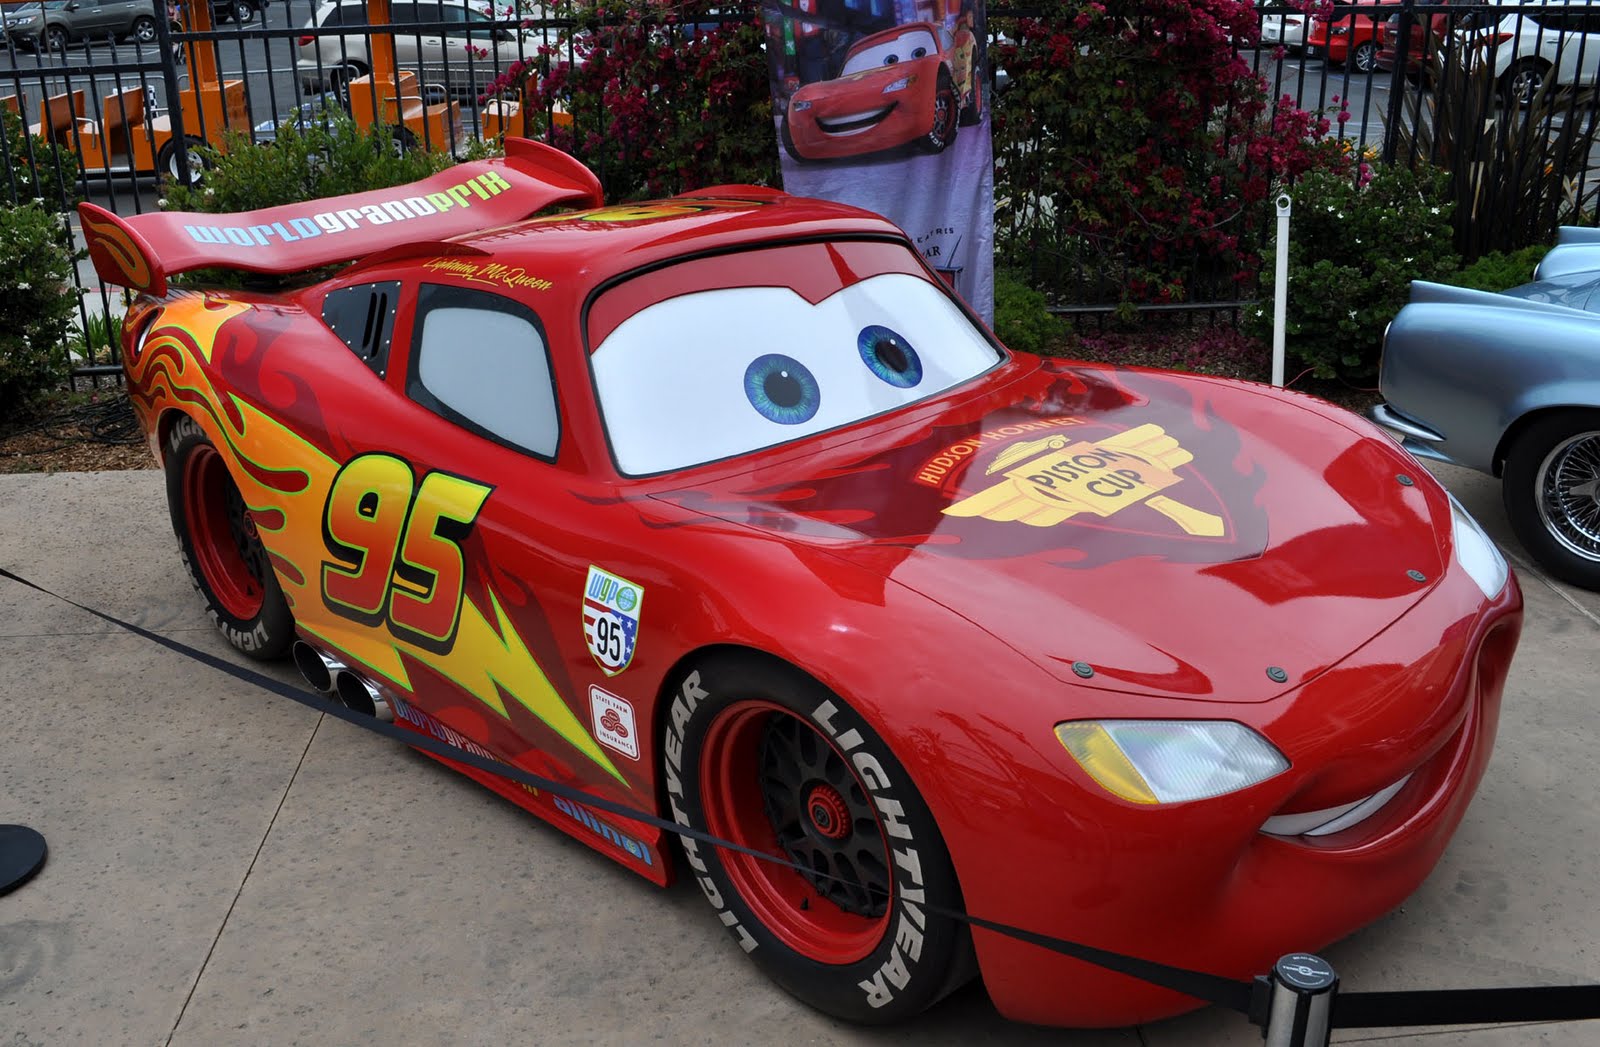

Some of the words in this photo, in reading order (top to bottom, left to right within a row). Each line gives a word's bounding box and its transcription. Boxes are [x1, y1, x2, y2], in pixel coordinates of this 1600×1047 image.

[422, 256, 480, 273] Lightning
[476, 262, 553, 291] McQueen
[922, 245, 942, 259] AR
[918, 438, 988, 485] HUDSON
[982, 416, 1086, 441] HORNET
[1027, 447, 1123, 491] PISTON
[1086, 469, 1146, 498] CUP
[321, 451, 496, 654] 95
[597, 617, 621, 662] 95
[595, 694, 611, 706] STATE
[612, 702, 628, 714] FARM
[599, 729, 633, 751] INSURANCE
[665, 669, 759, 954] LIGHTYEAR
[811, 699, 926, 1009] LIGHTYEAR
